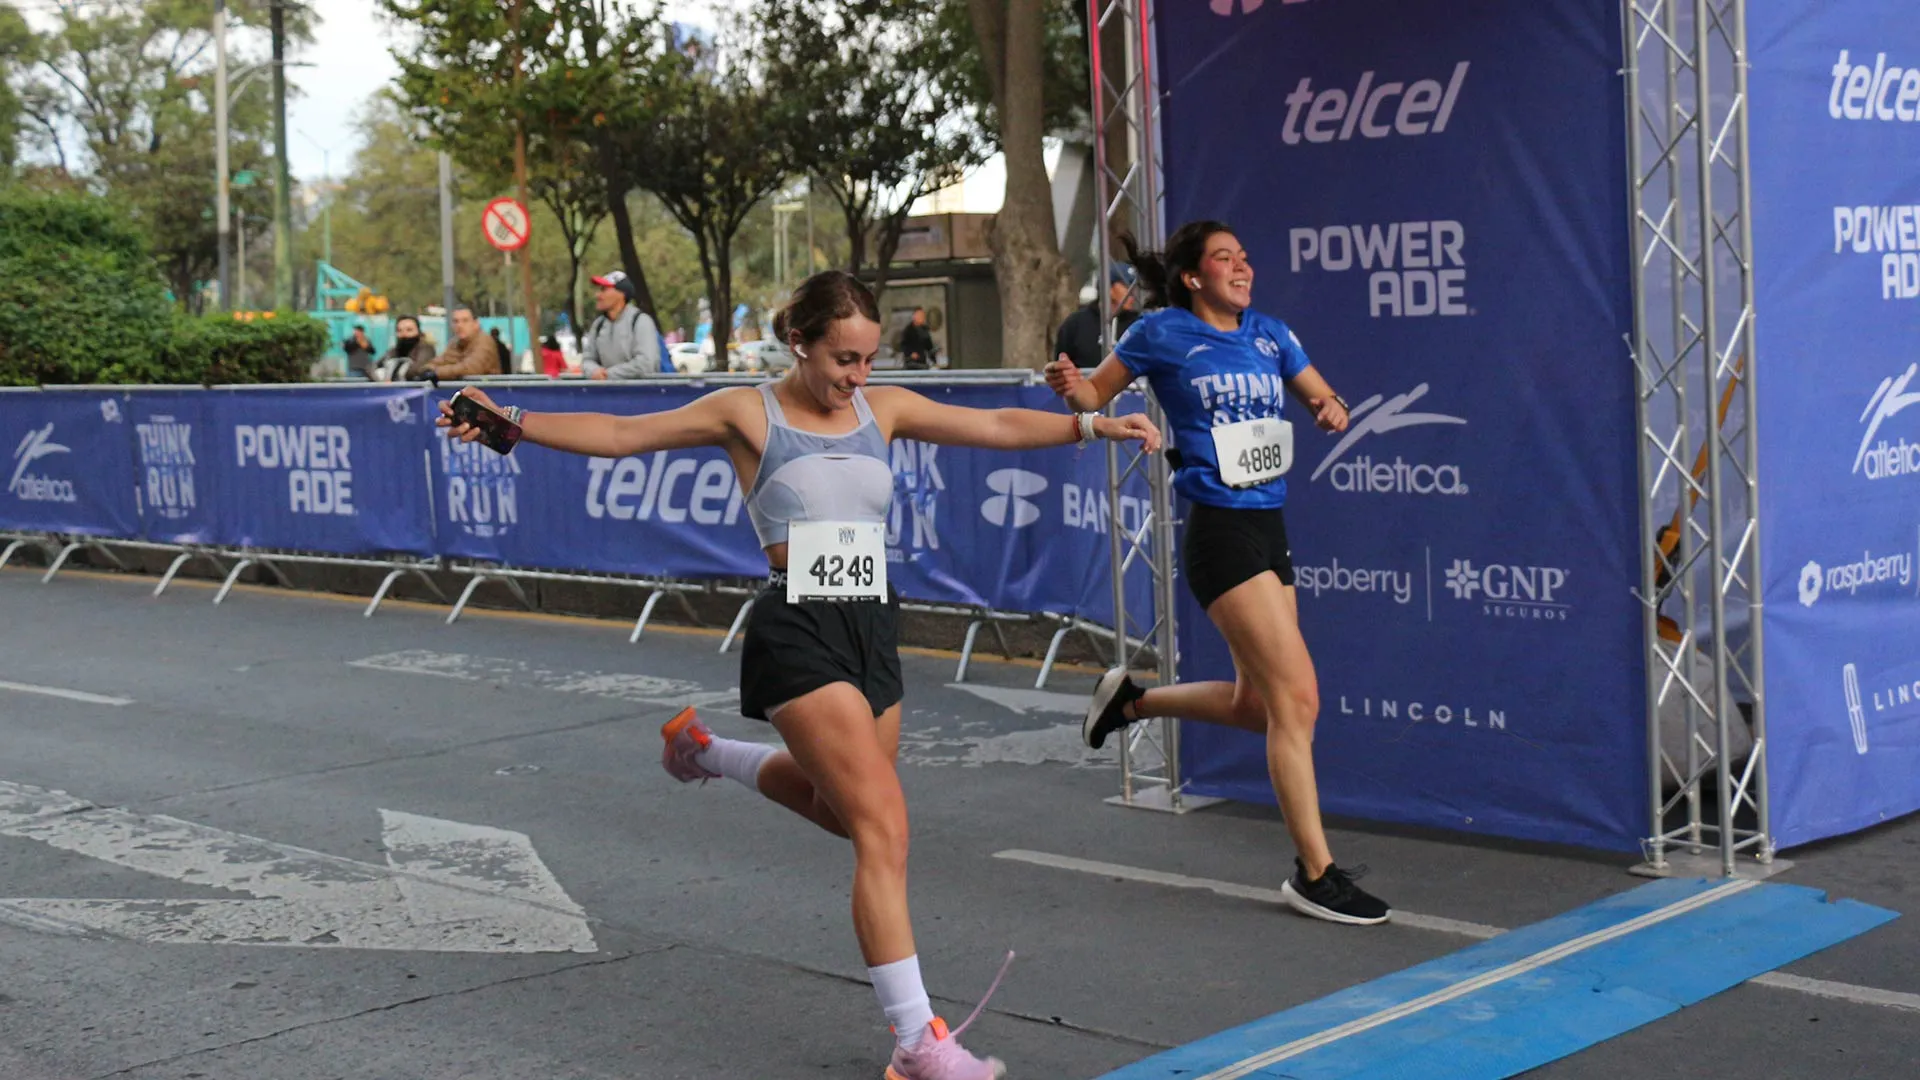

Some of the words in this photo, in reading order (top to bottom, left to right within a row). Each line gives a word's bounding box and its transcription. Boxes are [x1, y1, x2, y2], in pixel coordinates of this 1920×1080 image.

[1281, 60, 1471, 145] telcel
[1828, 49, 1920, 122] telce
[1289, 219, 1466, 273] POWER
[1369, 268, 1468, 317] ADE
[1881, 252, 1920, 300] AD
[135, 423, 196, 466] THINK
[234, 424, 352, 469] POWER
[1237, 443, 1282, 474] 4888
[147, 465, 197, 509] RUN
[288, 469, 354, 515] ADE
[585, 450, 744, 526] telcel
[1330, 455, 1461, 494] atletica
[447, 475, 519, 524] RUN
[808, 554, 874, 587] 4249
[1482, 563, 1566, 602] GNP
[1825, 550, 1911, 596] raspberry
[1482, 604, 1568, 621] SEGUROS
[1340, 695, 1506, 730] LINCOLN
